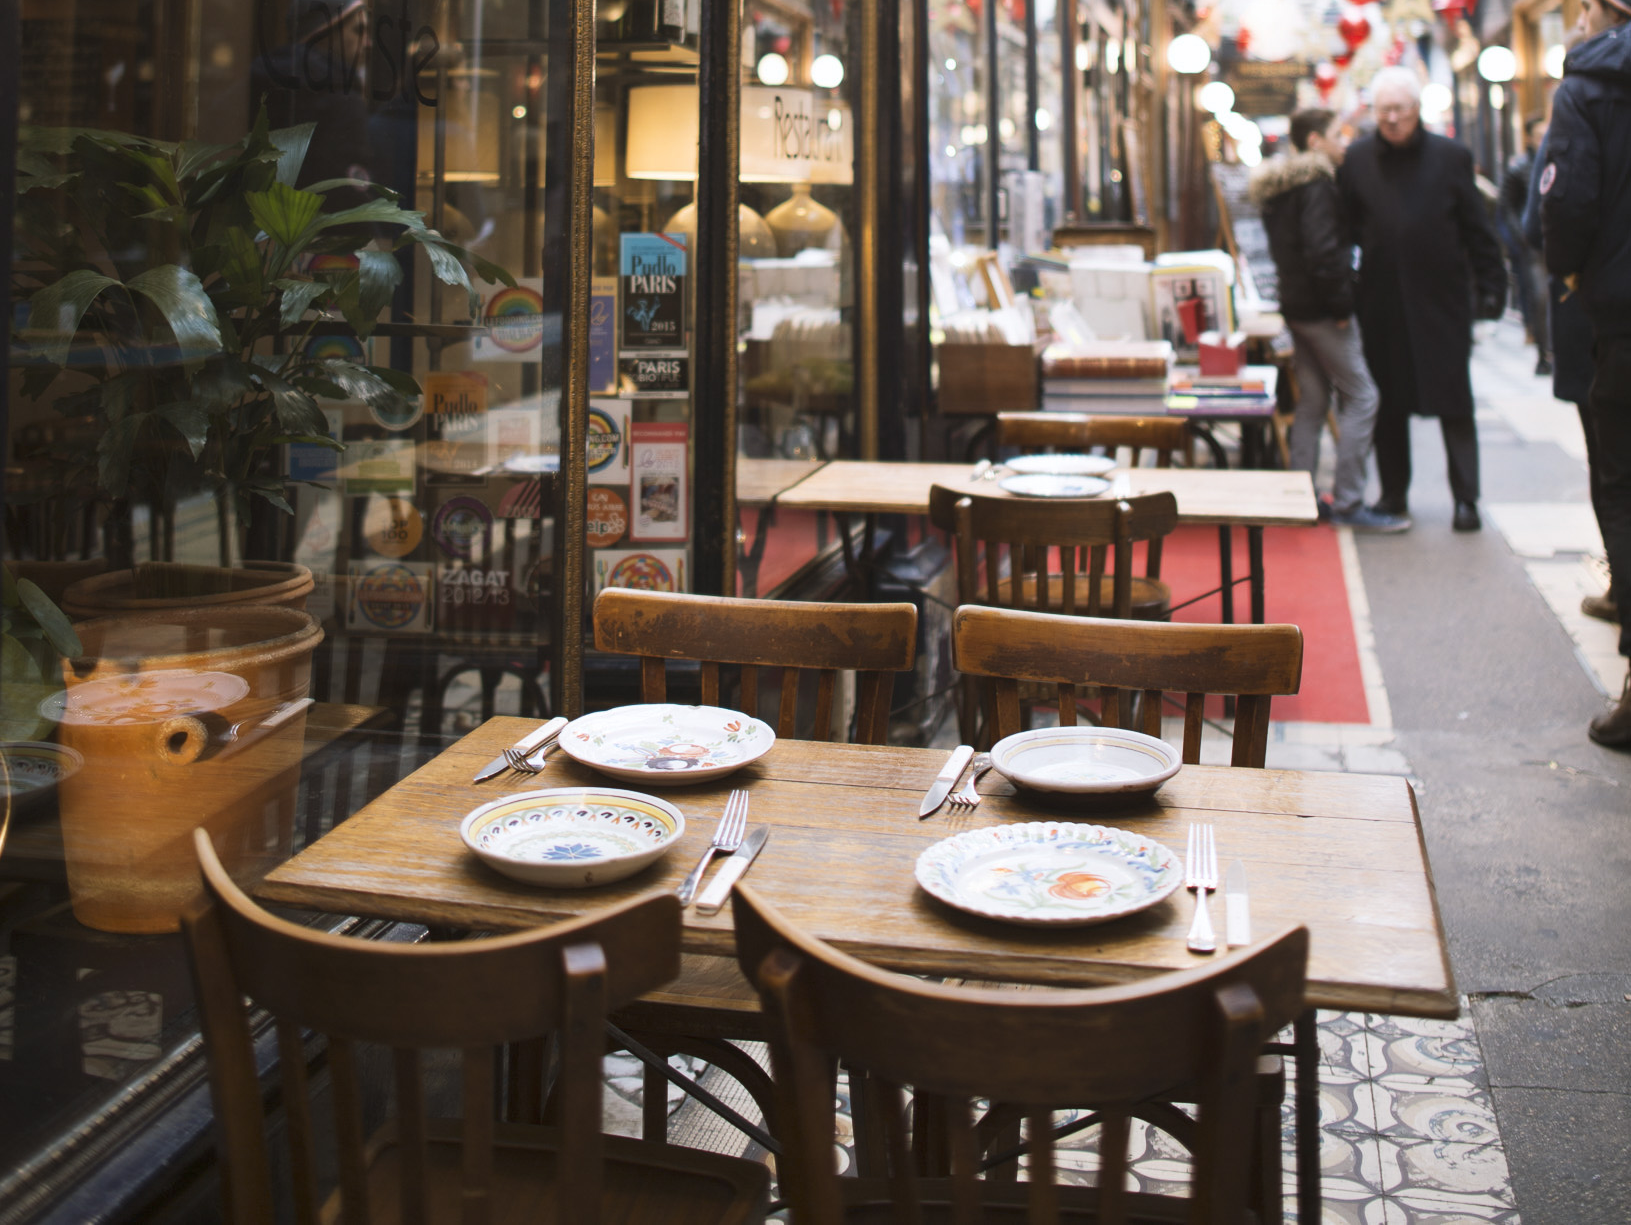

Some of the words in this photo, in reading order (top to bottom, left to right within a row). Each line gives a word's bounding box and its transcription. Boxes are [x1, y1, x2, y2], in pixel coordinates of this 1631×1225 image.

[631, 255, 676, 275] Pudlo
[630, 275, 677, 294] PARIS
[651, 321, 676, 331] 2015
[638, 361, 680, 374] PARIS
[434, 393, 478, 414] Pudlo
[443, 569, 509, 587] ZAGAT
